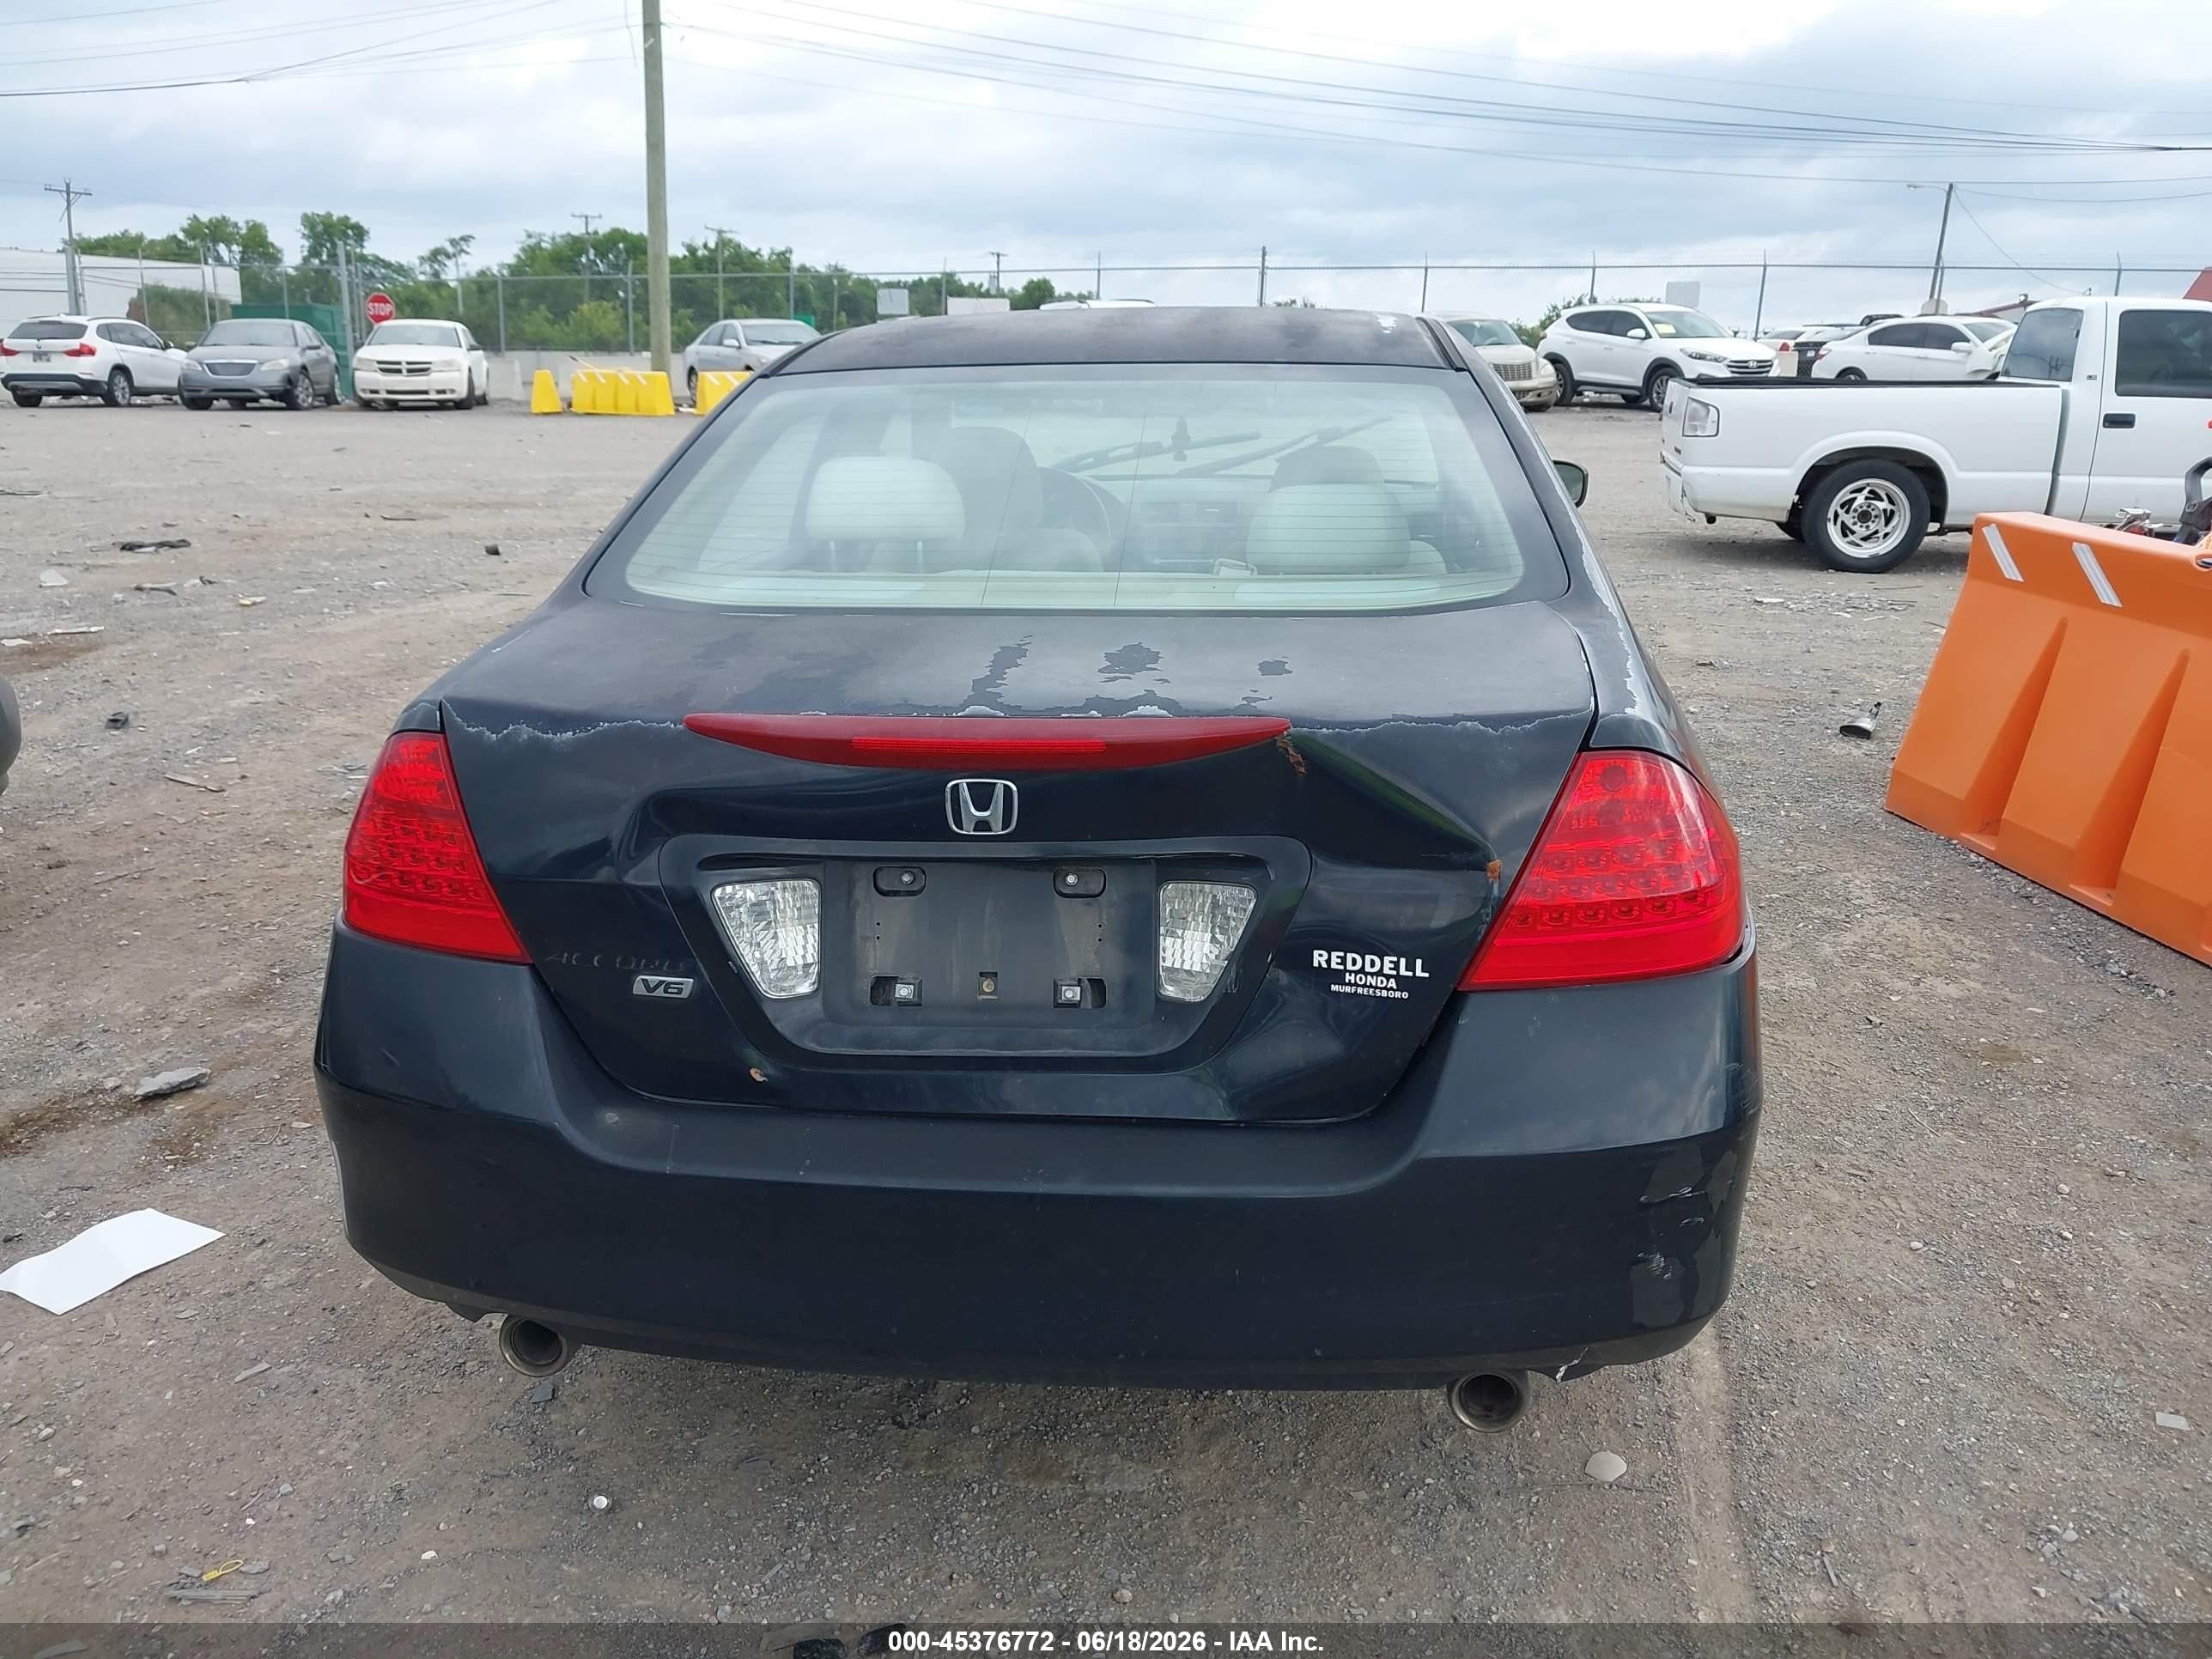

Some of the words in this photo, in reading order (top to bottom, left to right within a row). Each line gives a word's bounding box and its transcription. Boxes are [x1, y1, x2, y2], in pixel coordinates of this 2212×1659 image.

[368, 301, 392, 316] STOP
[1312, 950, 1430, 978] REDDELL
[641, 977, 684, 995] V6
[1345, 972, 1398, 989] HONDA
[1330, 984, 1410, 1000] MURFREESBORO
